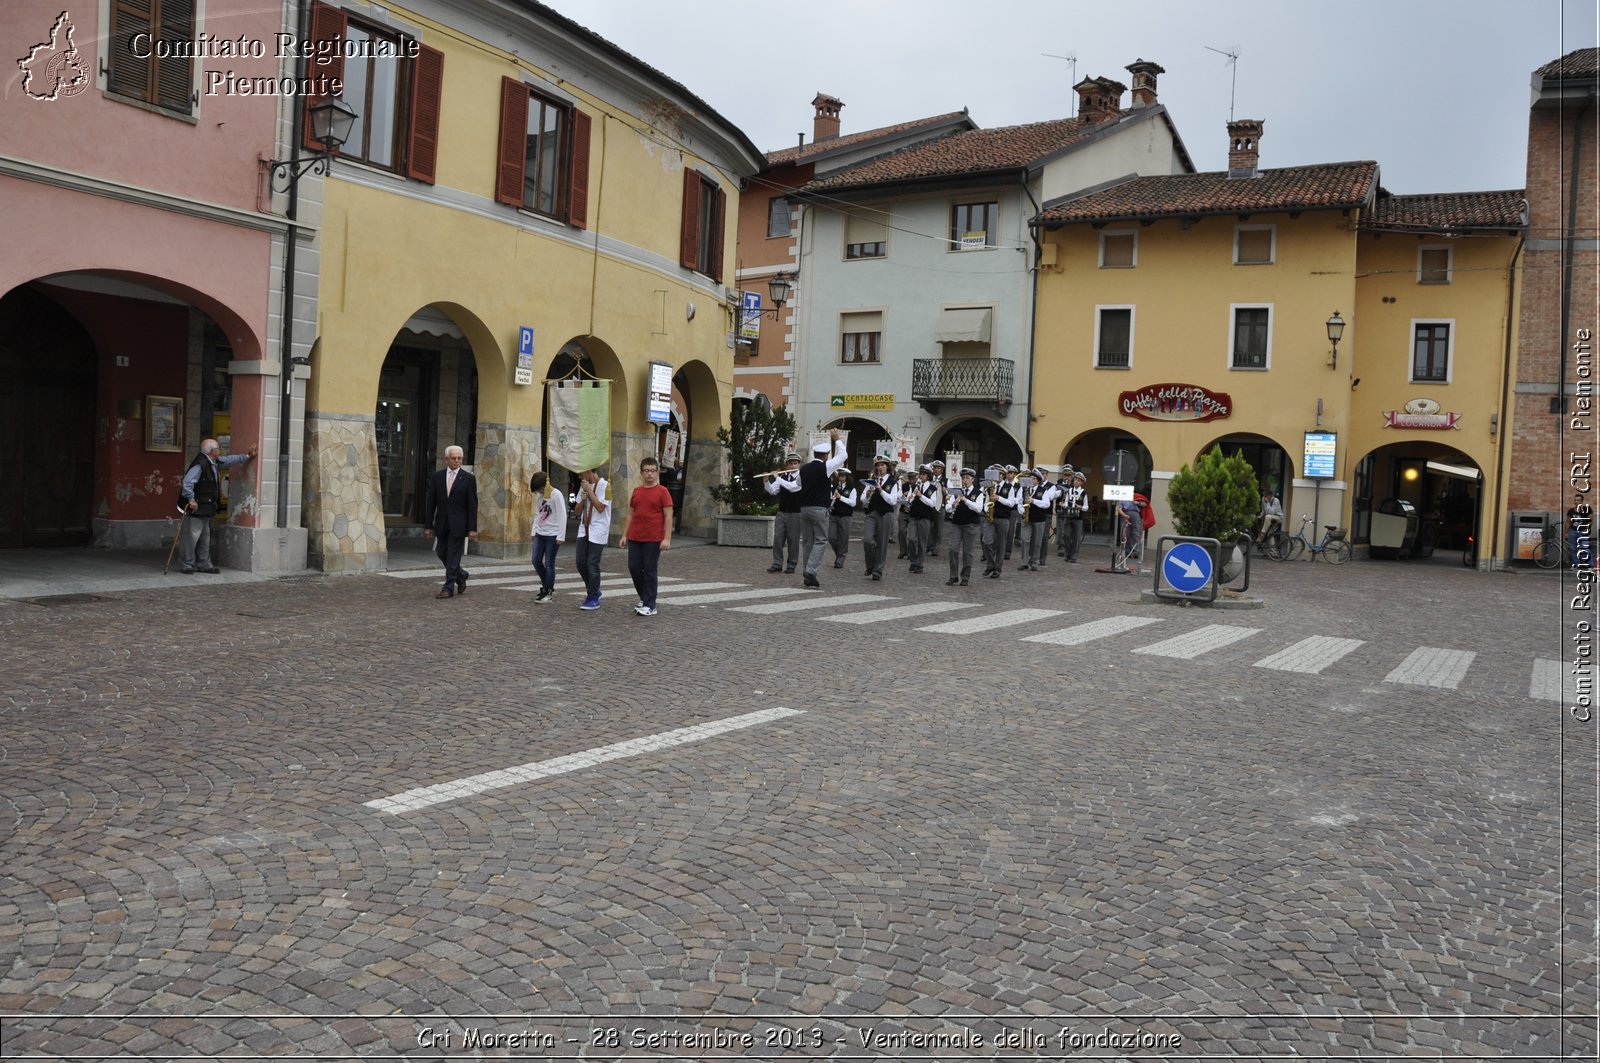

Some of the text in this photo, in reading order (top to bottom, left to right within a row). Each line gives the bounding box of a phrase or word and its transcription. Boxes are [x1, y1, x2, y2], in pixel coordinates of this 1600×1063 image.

[521, 329, 531, 351] P
[845, 394, 894, 402] CENTROCASE
[1158, 386, 1189, 399] della
[1192, 387, 1228, 415] Piazza
[1400, 419, 1442, 428] LOCANDA
